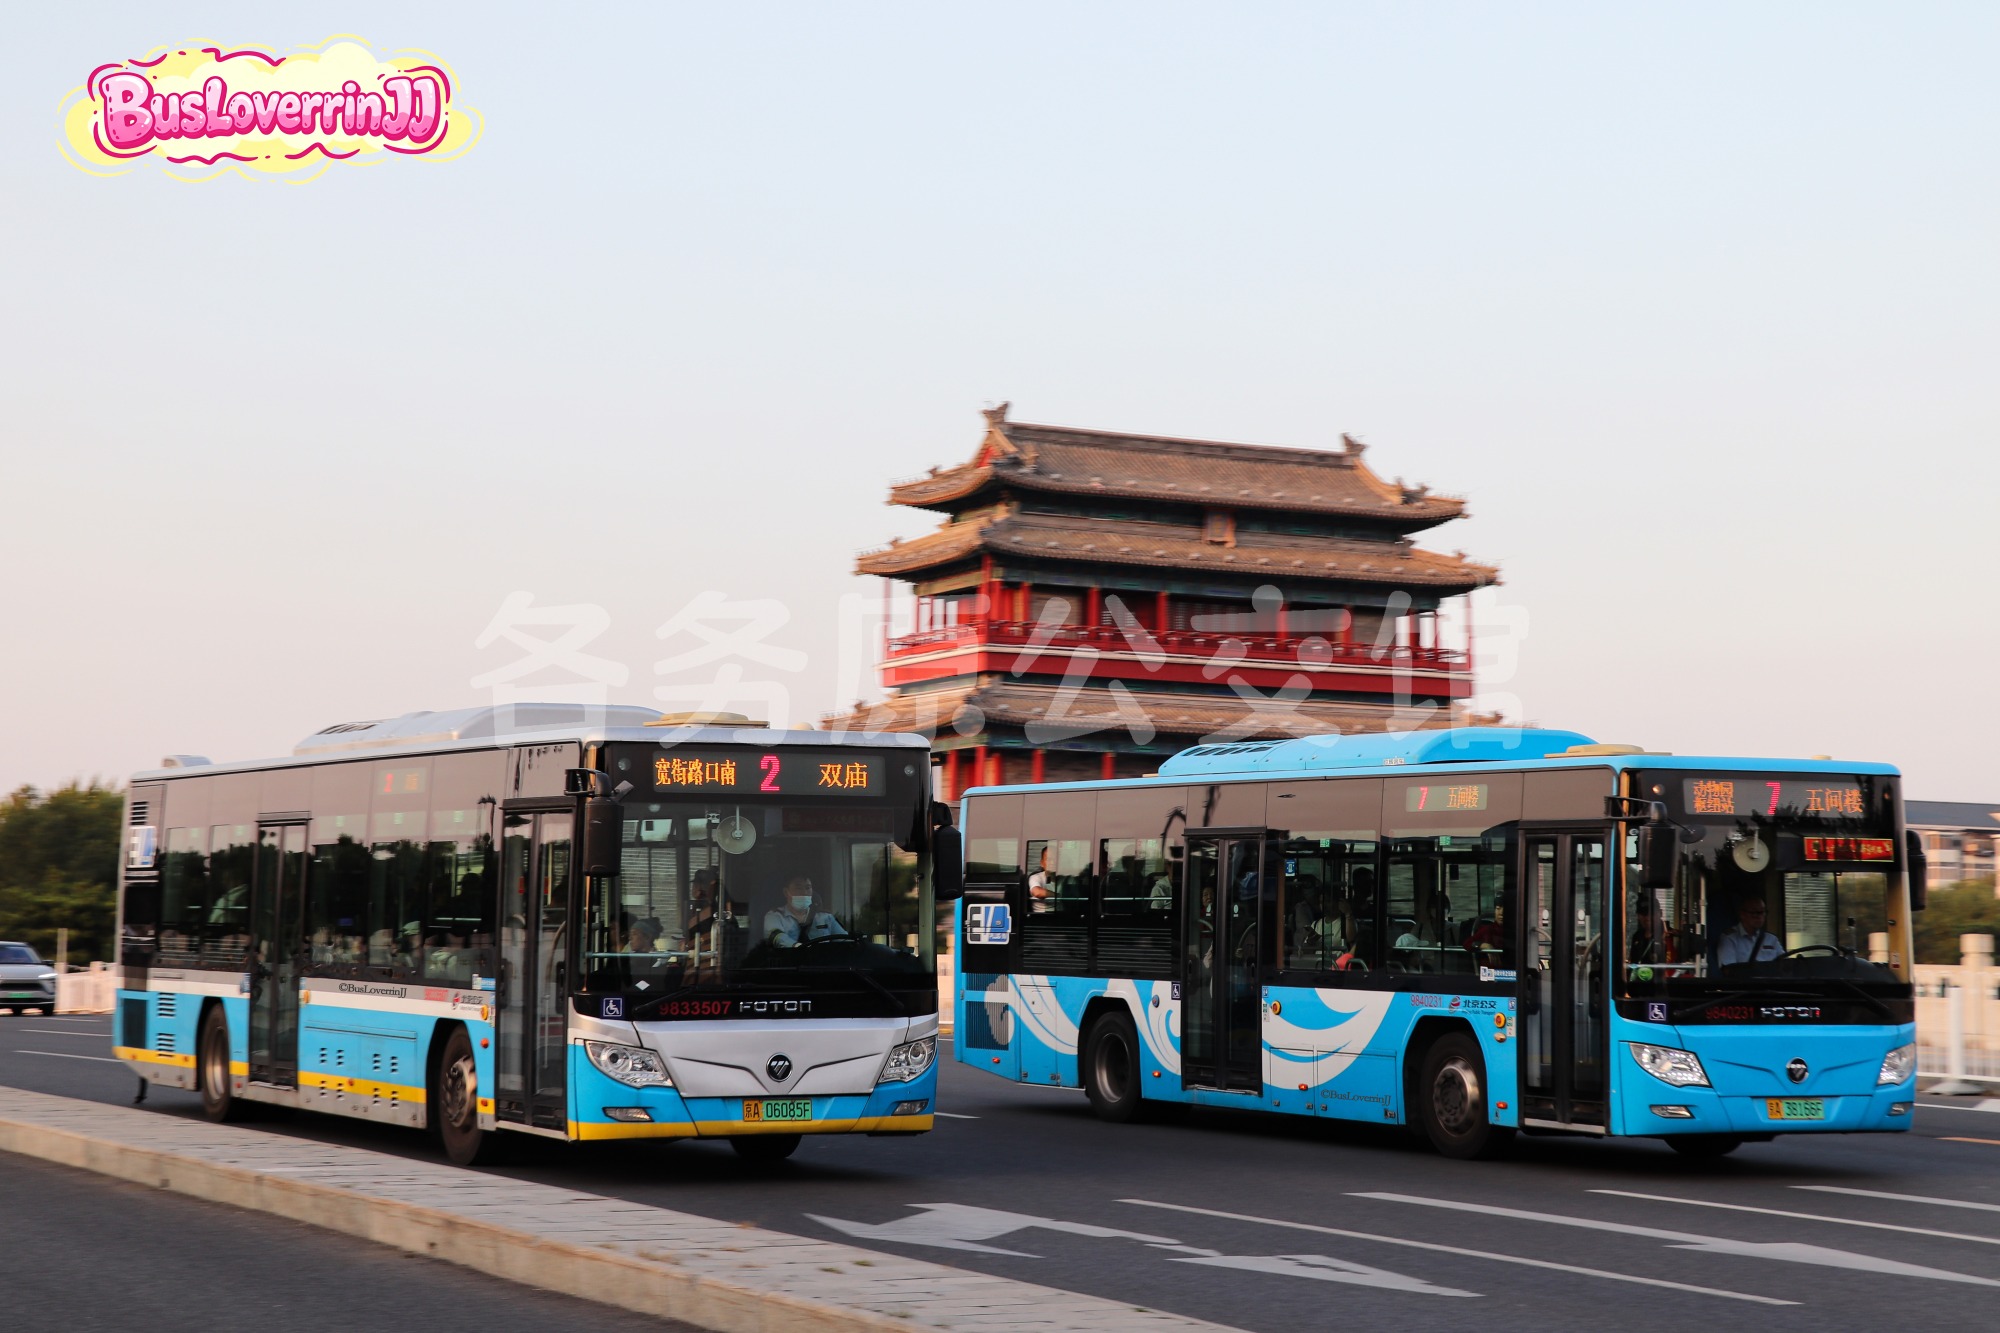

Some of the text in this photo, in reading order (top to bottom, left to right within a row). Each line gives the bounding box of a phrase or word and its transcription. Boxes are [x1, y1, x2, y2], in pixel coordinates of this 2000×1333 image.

[655, 756, 868, 791] 宽街路口南 2 双庙
[1418, 786, 1428, 809] 7
[1765, 782, 1781, 815] 7
[1806, 788, 1863, 813] 五间楼
[658, 1000, 812, 1016] 9833507 FOTON
[1410, 995, 1442, 1007] 9840231
[1463, 999, 1497, 1009] 北京公交
[1760, 1007, 1820, 1018] FOTON
